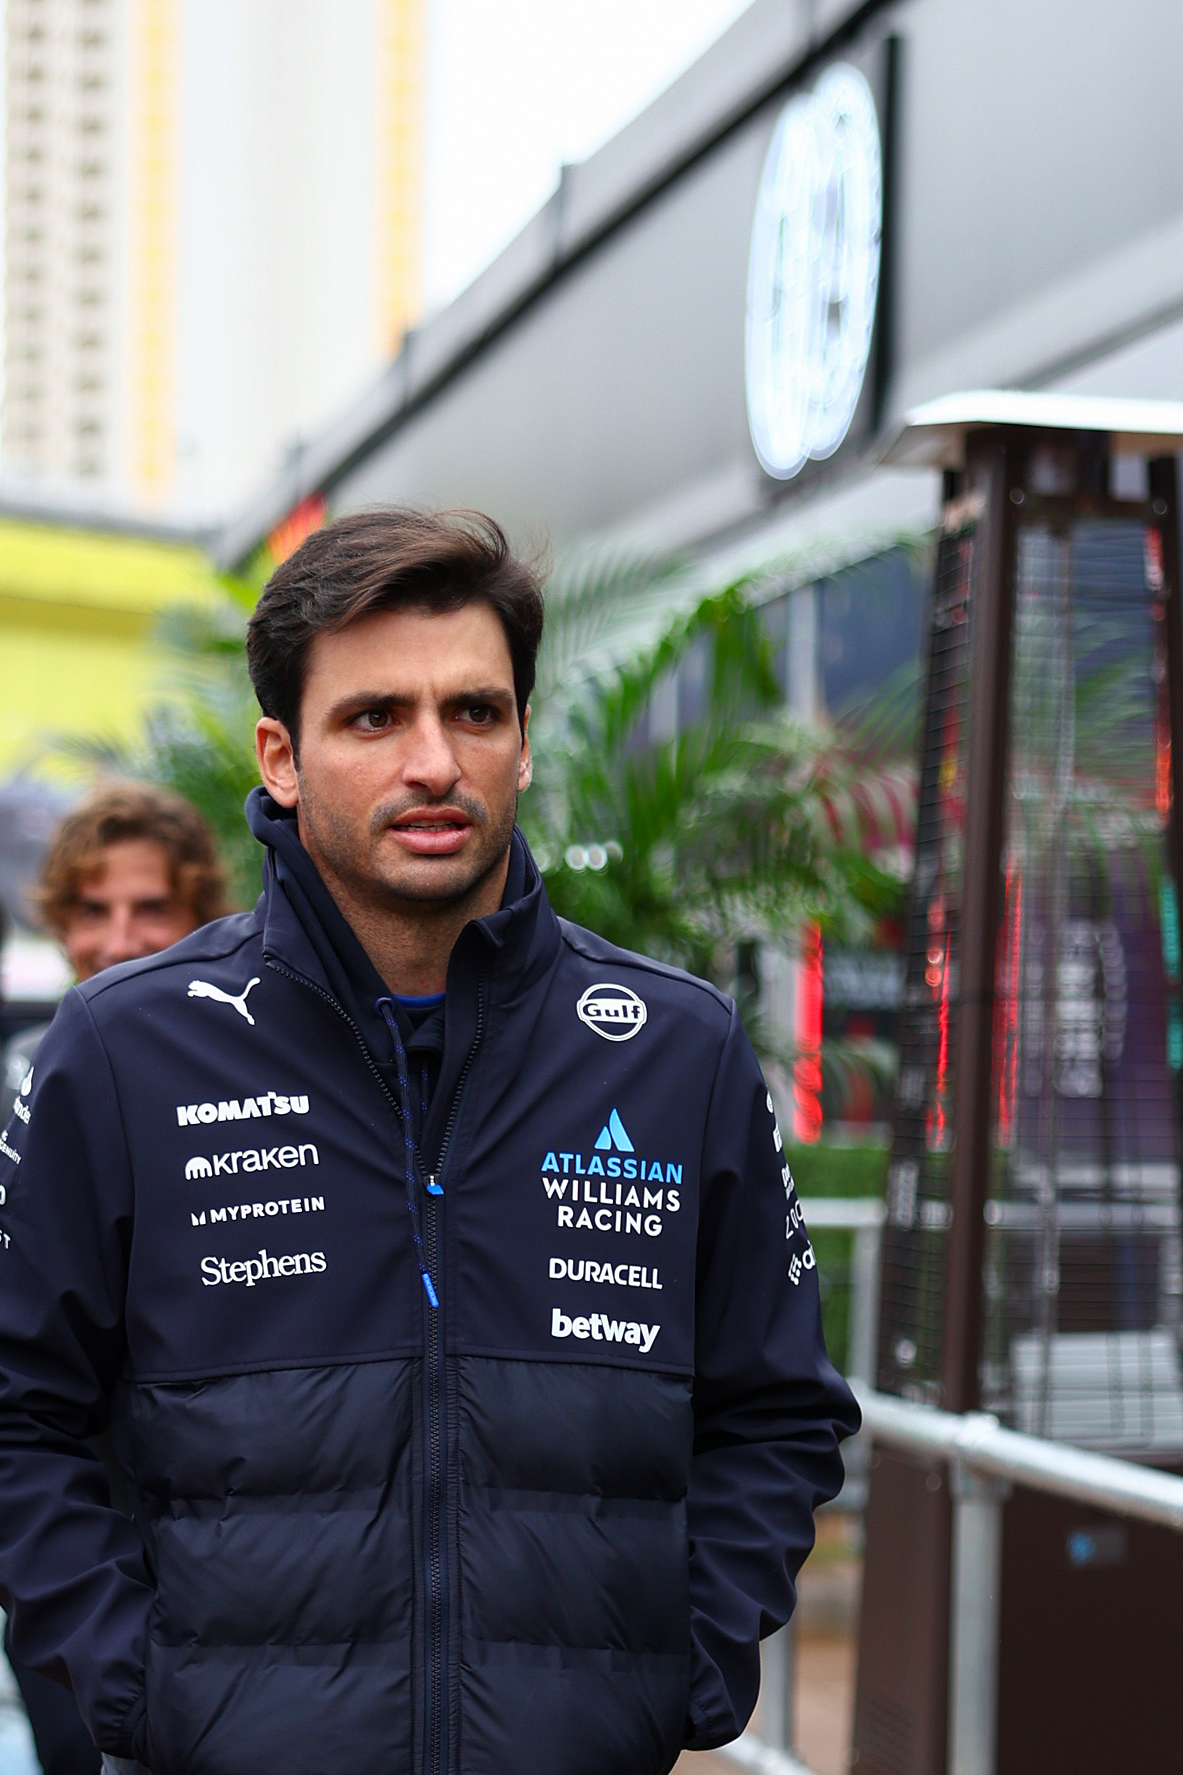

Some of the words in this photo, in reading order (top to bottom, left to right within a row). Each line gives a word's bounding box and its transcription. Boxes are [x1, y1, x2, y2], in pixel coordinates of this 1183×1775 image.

[582, 1002, 642, 1020] Gulf
[176, 1091, 310, 1127] KOMATSU
[540, 1152, 683, 1185] ATLASSIAN
[209, 1196, 326, 1224] MYPROTEIN
[542, 1177, 681, 1212] WILLIAMS
[557, 1205, 663, 1237] RACING
[200, 1249, 327, 1287] Stephens
[549, 1257, 663, 1290] DURACELL
[551, 1308, 661, 1353] betway
